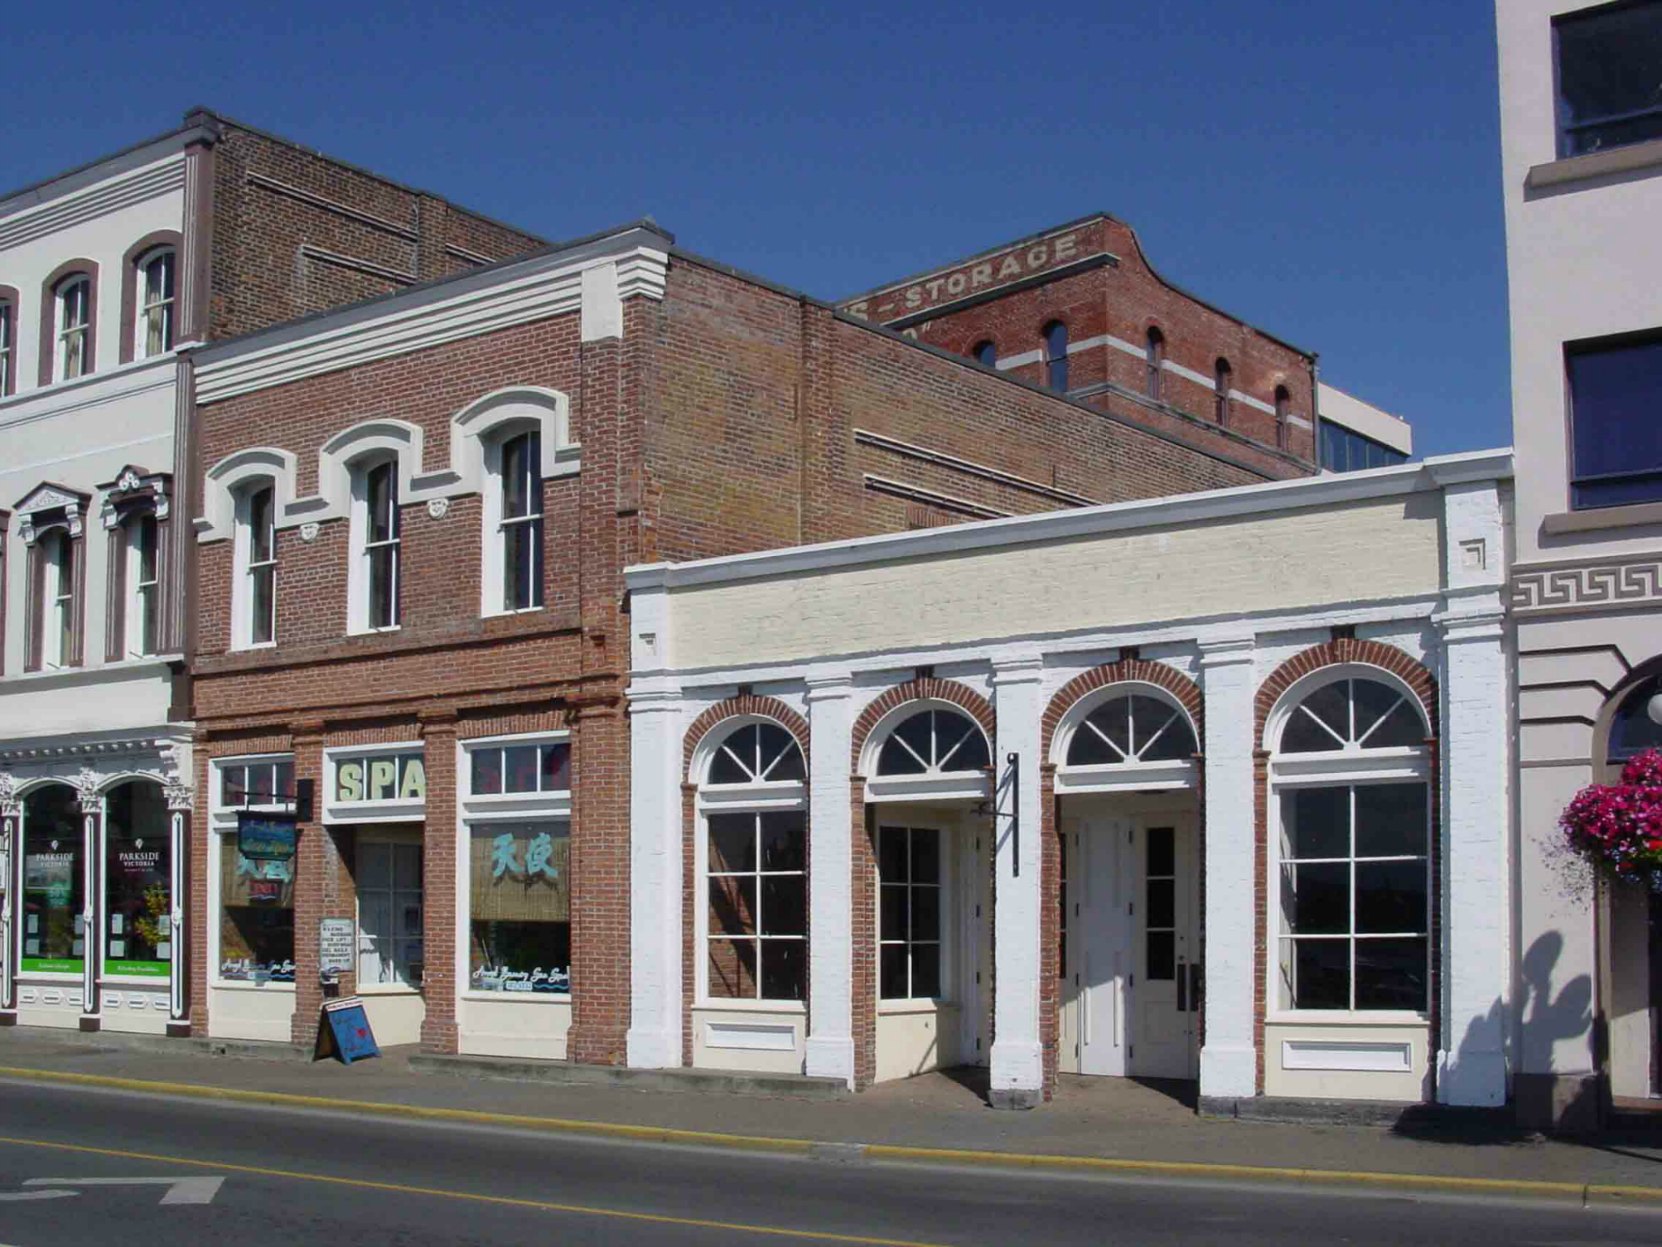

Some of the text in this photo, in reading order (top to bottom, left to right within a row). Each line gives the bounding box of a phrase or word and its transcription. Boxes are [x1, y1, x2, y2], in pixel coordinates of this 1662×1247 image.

[905, 234, 1078, 309] STORAGE
[340, 759, 425, 801] SPA
[36, 853, 74, 862] PARKSIDE
[119, 852, 160, 862] PARKSIDE
